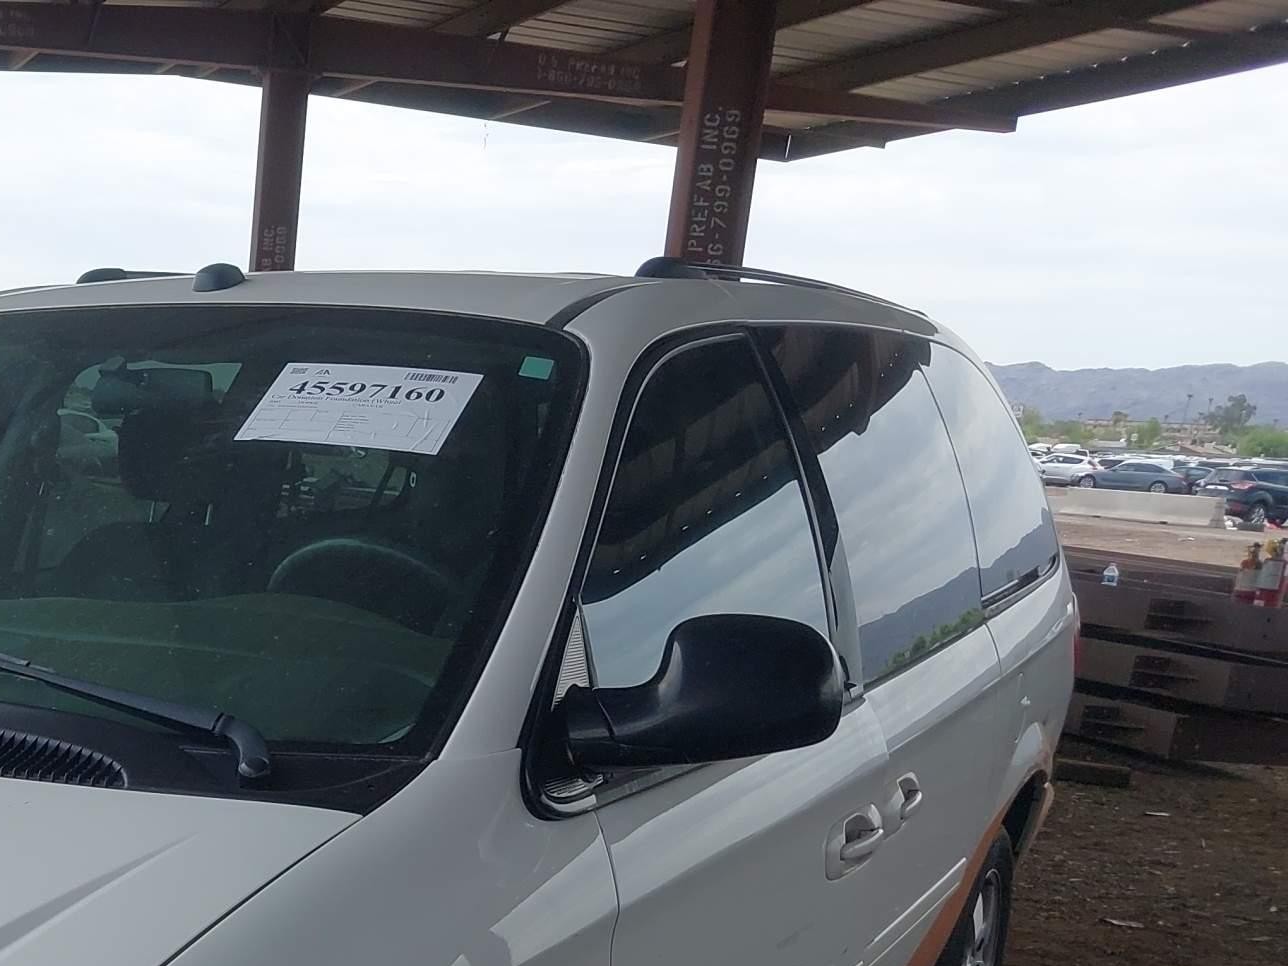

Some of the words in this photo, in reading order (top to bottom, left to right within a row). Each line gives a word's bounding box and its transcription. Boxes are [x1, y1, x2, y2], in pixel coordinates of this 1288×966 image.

[688, 163, 714, 251] PREFAB
[701, 106, 722, 150] INC.
[289, 379, 446, 403] 45597160
